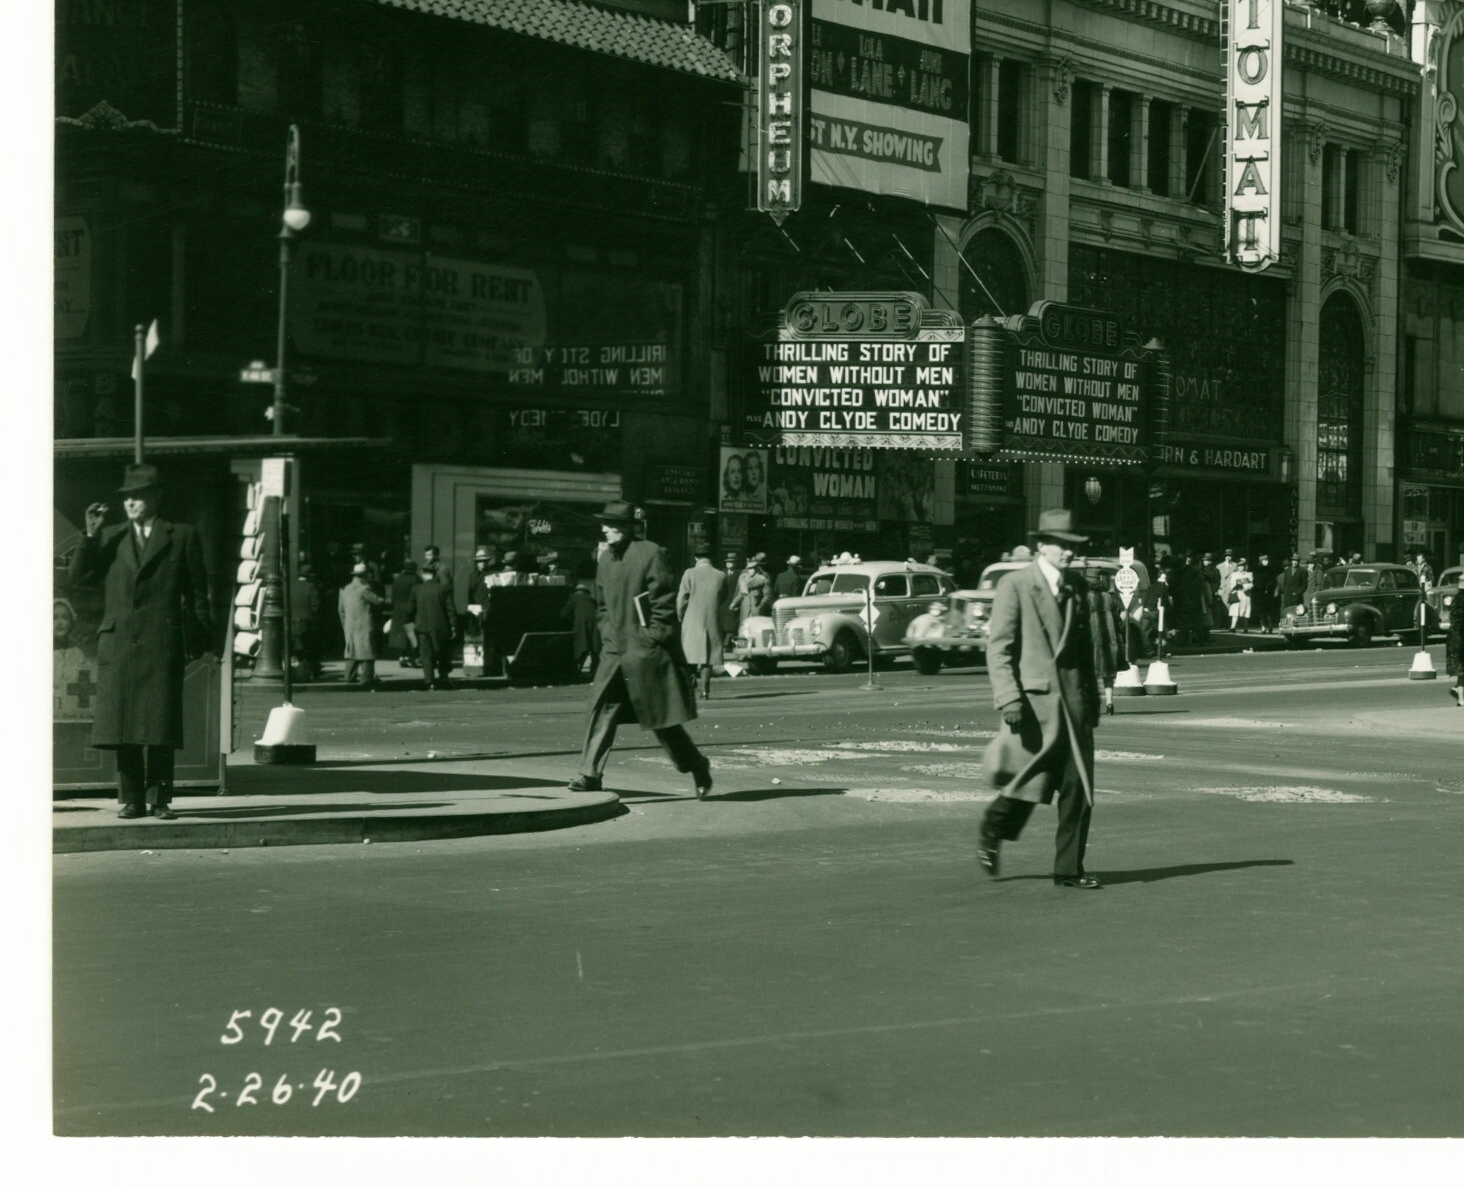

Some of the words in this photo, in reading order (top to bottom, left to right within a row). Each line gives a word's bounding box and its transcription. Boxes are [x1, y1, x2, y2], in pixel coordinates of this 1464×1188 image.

[850, 55, 893, 99] LANE
[767, 3, 793, 203] ORPHEUM
[830, 122, 858, 151] N.Y.
[863, 128, 934, 166] SHOWING
[471, 271, 534, 305] RENT
[795, 303, 911, 332] GLOBE
[1045, 312, 1117, 347] GLOBE
[762, 342, 849, 362] THRILLING
[859, 342, 918, 362] STORY
[928, 343, 952, 362] OF
[1019, 348, 1078, 372] THRILLING
[1082, 356, 1119, 378] STORY
[1123, 362, 1139, 380] OF
[758, 365, 818, 385] WOMEN
[829, 365, 906, 385] WITHOUT
[916, 366, 954, 385] MEN
[1015, 370, 1058, 393] WOMEN
[1063, 376, 1112, 398] WITHOUT
[1117, 382, 1140, 402] MEN
[761, 387, 864, 407] "CONVICTED
[873, 388, 950, 408] WOMAN"
[1016, 394, 1086, 418] "CONVICTED
[1091, 401, 1138, 423] WOMAN"
[762, 411, 809, 429] ANDY
[819, 411, 878, 430] CLYDE
[888, 412, 962, 431] COMEDY
[1013, 416, 1046, 436] ANDY
[1052, 419, 1089, 440] CLYDE
[1094, 424, 1139, 445] COMEDY
[775, 444, 874, 472] CONVICTED
[1189, 449, 1199, 465] &
[1204, 447, 1267, 470] HARDART
[812, 471, 876, 500] WOMAN
[1290, 489, 1298, 555] AUTOMAT
[219, 1006, 342, 1046] 5942
